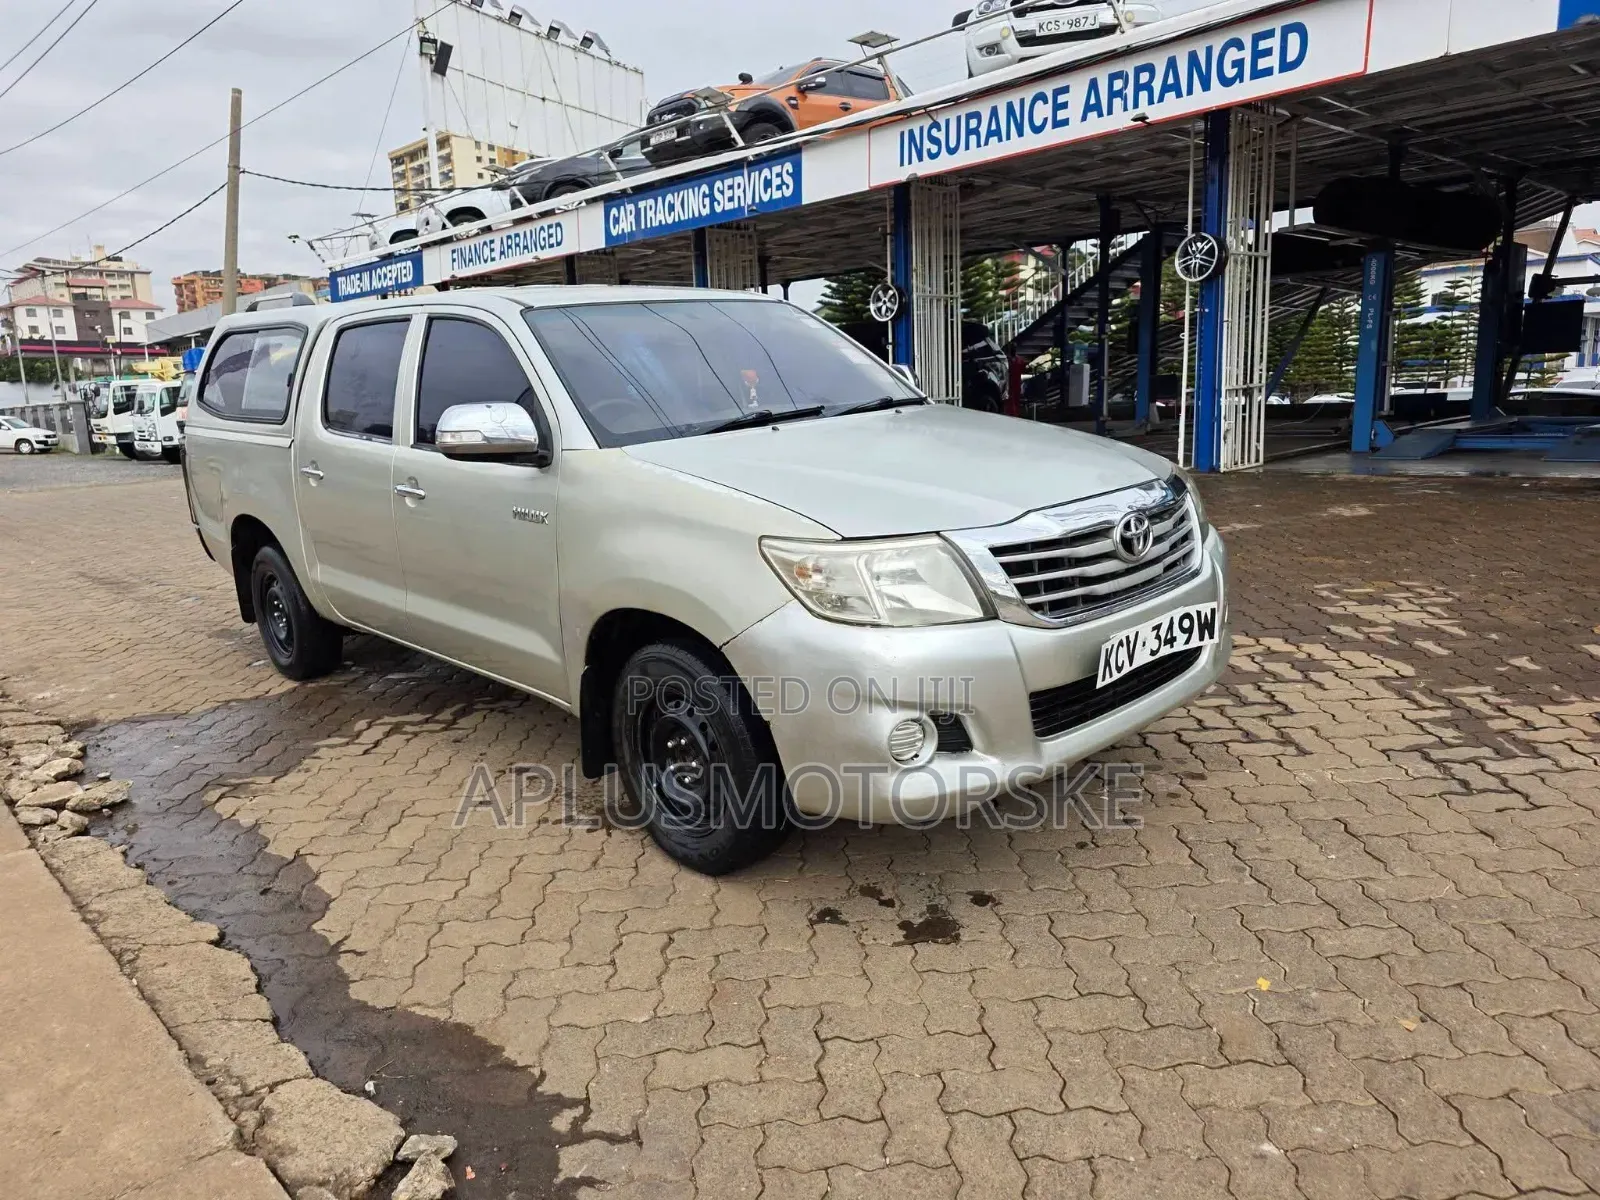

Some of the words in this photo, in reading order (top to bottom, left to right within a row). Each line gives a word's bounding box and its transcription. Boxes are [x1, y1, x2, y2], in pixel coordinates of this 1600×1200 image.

[899, 85, 1070, 167] INSURANCE
[1081, 21, 1309, 122] ARRANGED
[609, 202, 636, 237] CAR
[638, 183, 710, 230] TRACKING
[713, 162, 794, 213] SERVICES
[451, 239, 496, 271] FINANCE
[500, 222, 564, 260] ARRANGED
[337, 270, 370, 297] TRADE-IN
[371, 260, 413, 290] ACCEPTED
